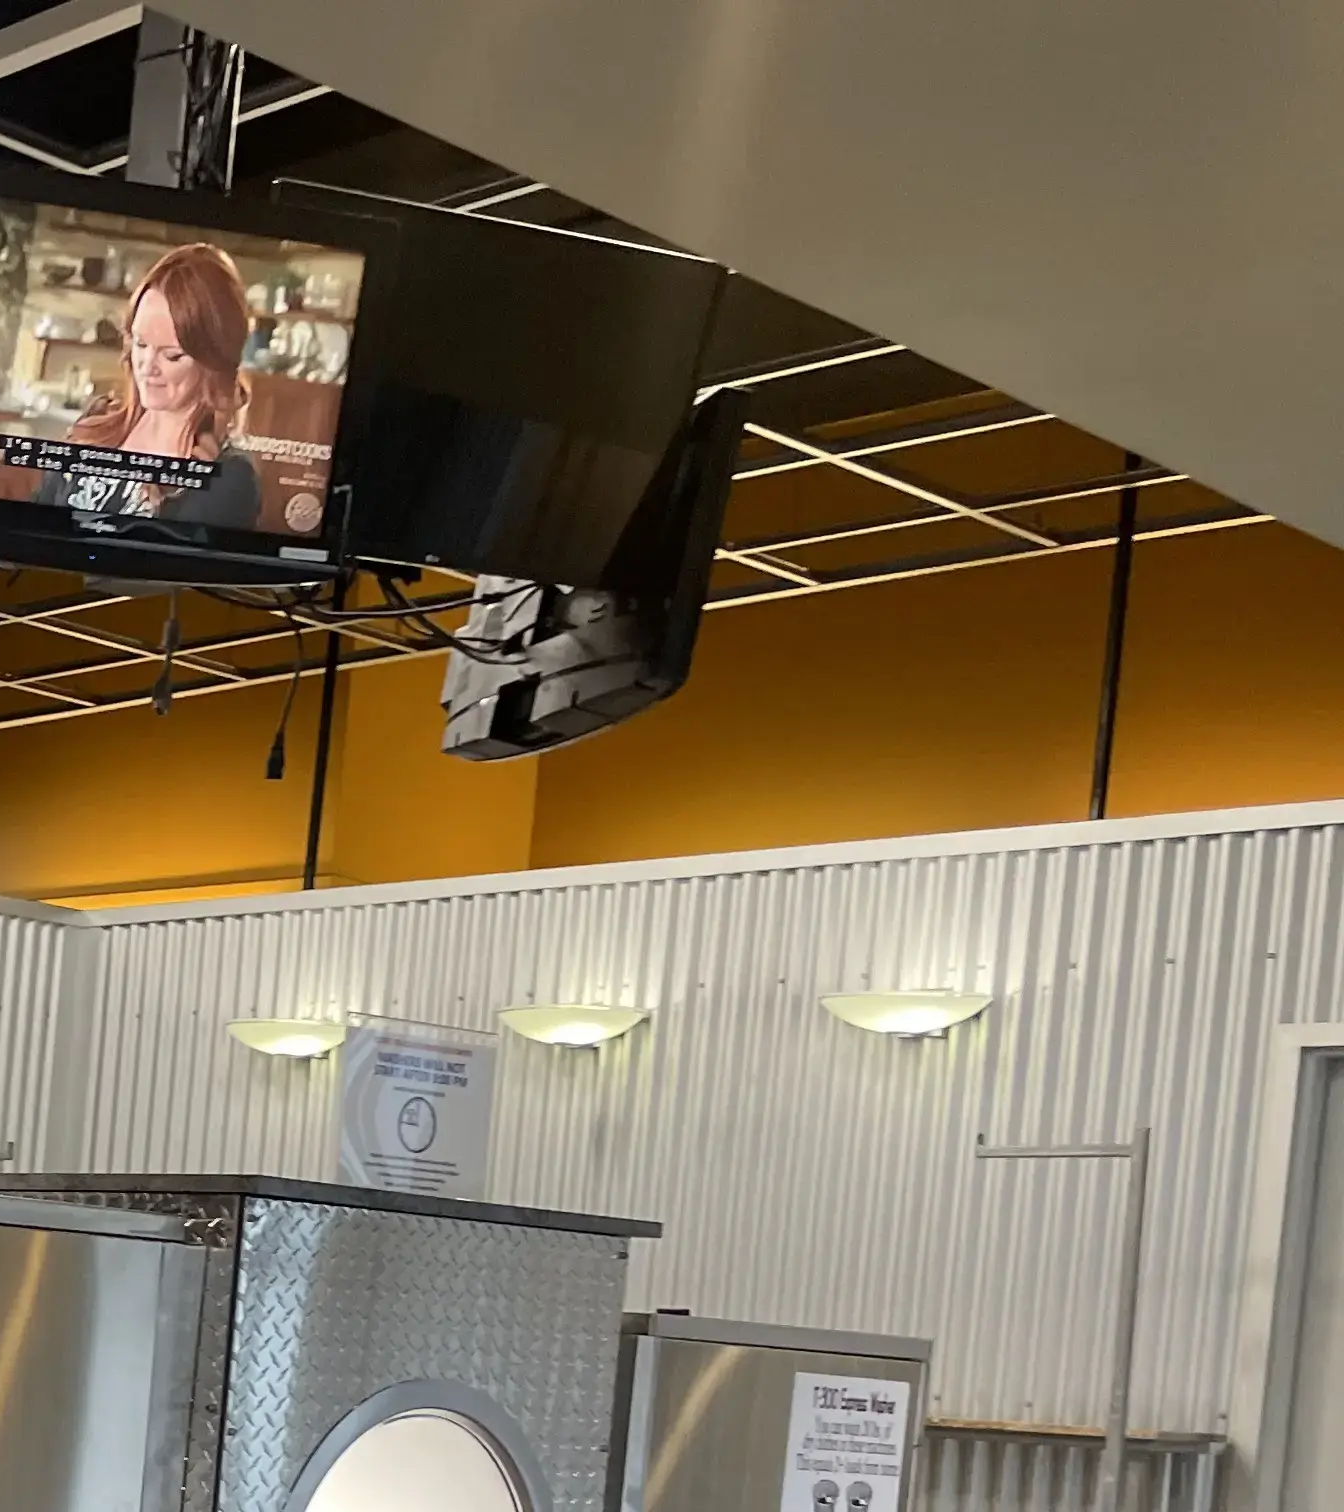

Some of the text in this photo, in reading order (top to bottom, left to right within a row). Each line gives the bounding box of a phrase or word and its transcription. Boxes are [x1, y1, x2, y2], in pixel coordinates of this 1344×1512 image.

[6, 437, 214, 474] I'm just gonna take a few
[11, 455, 203, 488] of the cheesecake bites
